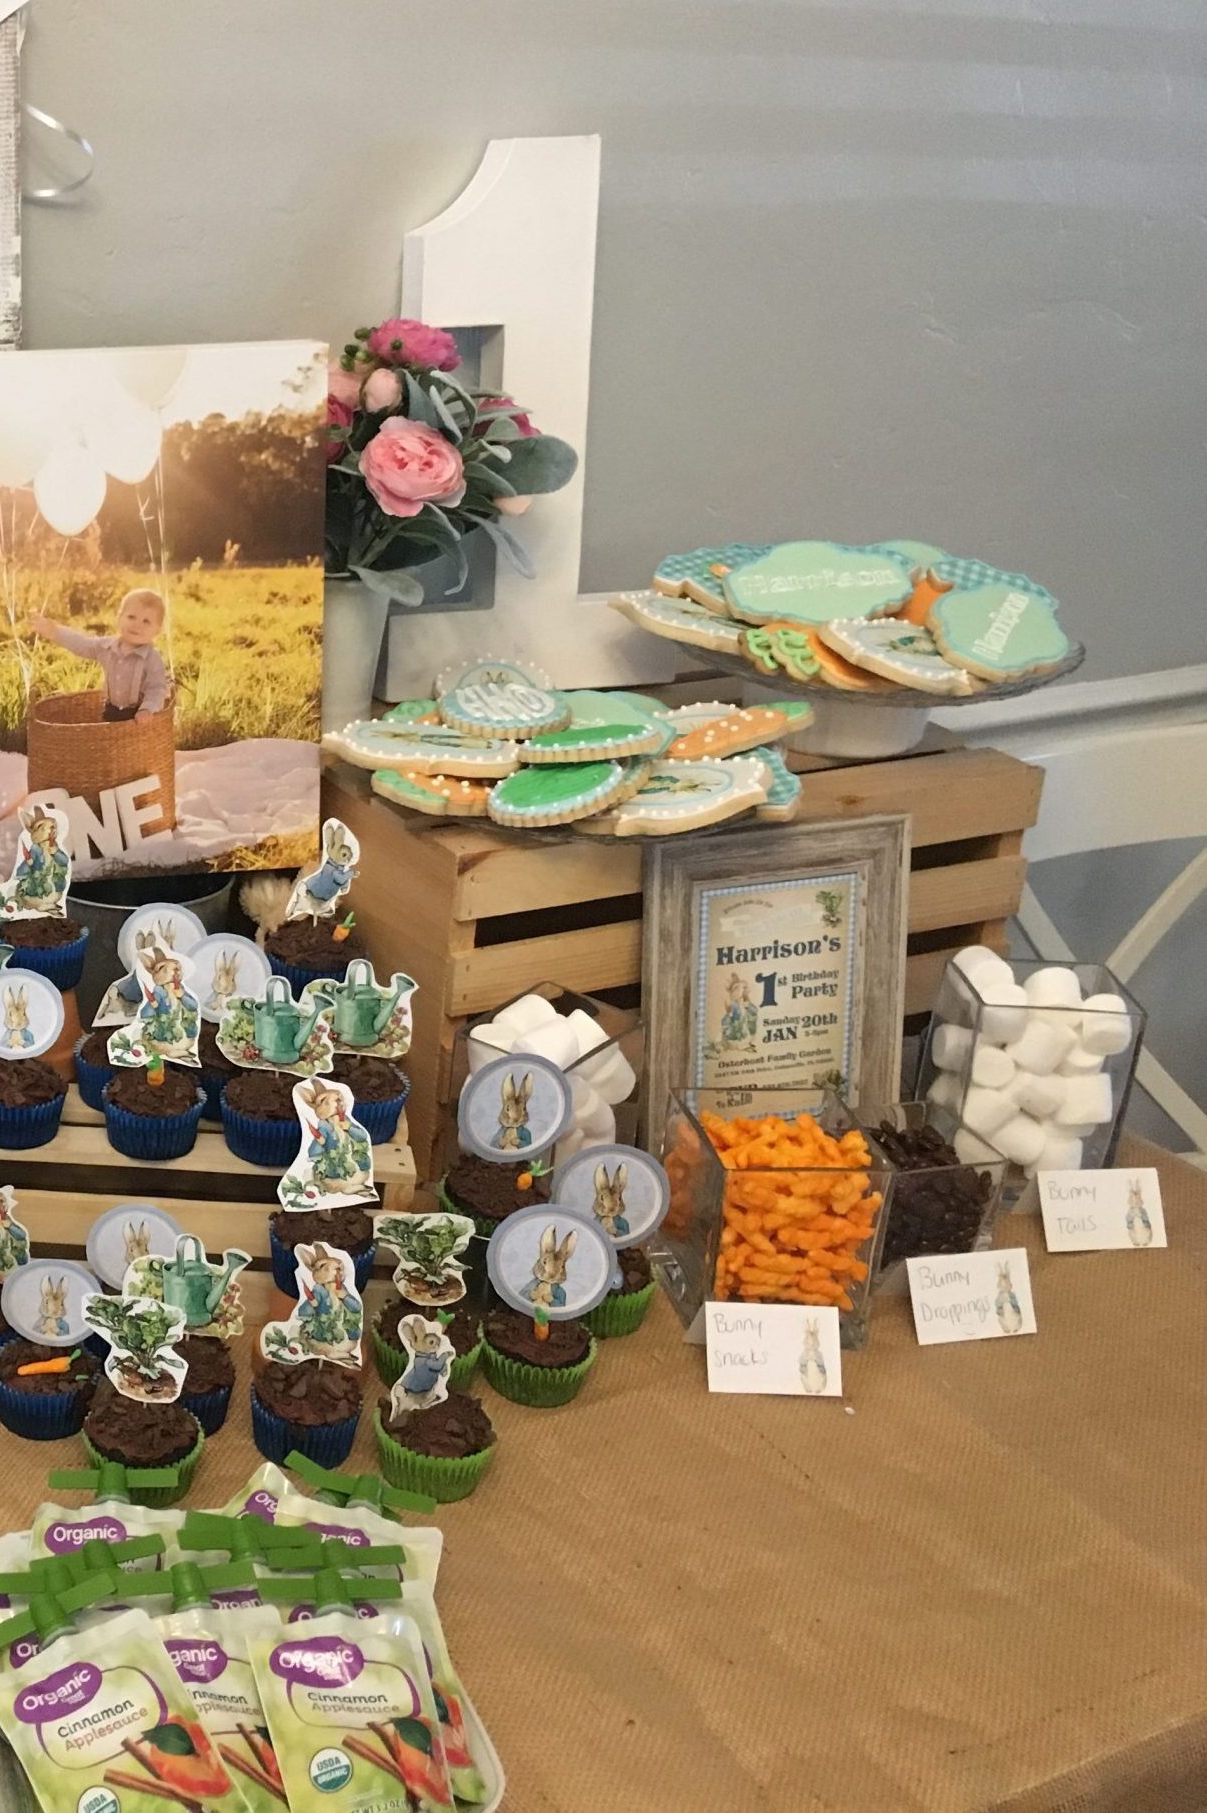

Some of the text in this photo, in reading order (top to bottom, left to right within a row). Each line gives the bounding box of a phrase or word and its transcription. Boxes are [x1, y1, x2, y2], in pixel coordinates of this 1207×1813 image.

[716, 934, 841, 966] Harrison's
[791, 969, 840, 983] Birthday
[792, 982, 839, 999] Party
[762, 1012, 838, 1028] Sunday 20th
[762, 1026, 798, 1043] JAN
[767, 1051, 797, 1063] Family
[1047, 1180, 1097, 1202] Bunny
[918, 1265, 970, 1290] Bunny
[713, 1312, 762, 1338] Bunny
[53, 1525, 118, 1545] Organic
[169, 1644, 218, 1667] ganic
[279, 1646, 354, 1674] Organic
[22, 1669, 91, 1710] Organic
[307, 1692, 388, 1703] Cinnamon
[58, 1699, 134, 1738] Cinnamon
[311, 1702, 401, 1715] Applesauce
[65, 1706, 149, 1752] Applesauce
[316, 1756, 342, 1772] USDA
[316, 1766, 349, 1783] ORGANIC
